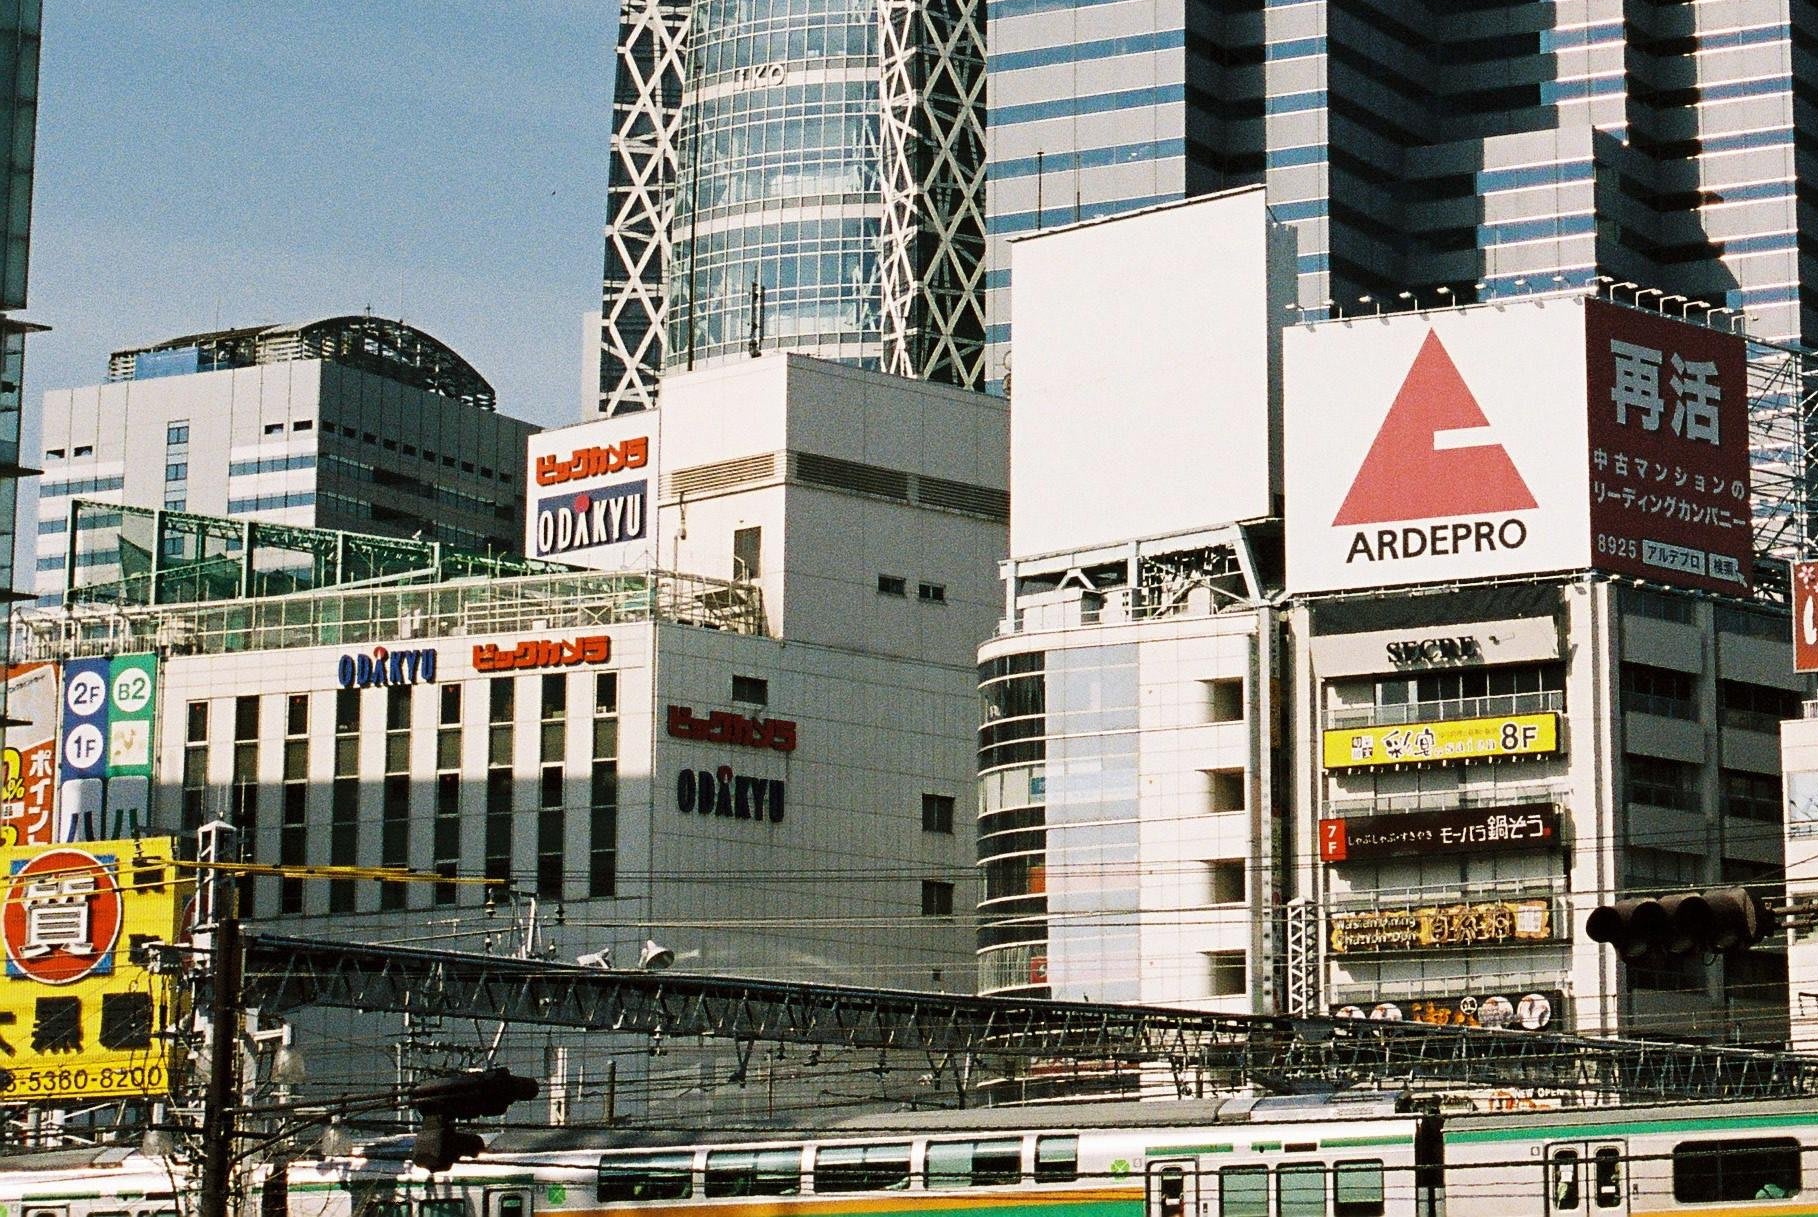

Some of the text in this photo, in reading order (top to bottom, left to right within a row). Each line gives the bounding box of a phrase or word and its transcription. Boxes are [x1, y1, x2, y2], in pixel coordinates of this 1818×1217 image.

[1609, 338, 1723, 446] 再活
[536, 435, 649, 487] ビックカメラ
[1593, 448, 1746, 501] 中古マンションの
[538, 492, 641, 554] ODAKYU
[1593, 480, 1747, 530] リーディングカンパニー
[1345, 518, 1528, 564] ARDEPRO
[1597, 532, 1638, 560] 8925
[337, 645, 438, 688] ODAKYU
[471, 635, 613, 672] ビックカメラ
[73, 682, 100, 705] 2F
[118, 677, 146, 701] B2
[73, 735, 96, 759] 1F
[667, 704, 798, 753] ビックカメラ
[1500, 723, 1538, 752] 8F
[676, 764, 786, 824] ODAKYU
[19, 870, 96, 959] 質
